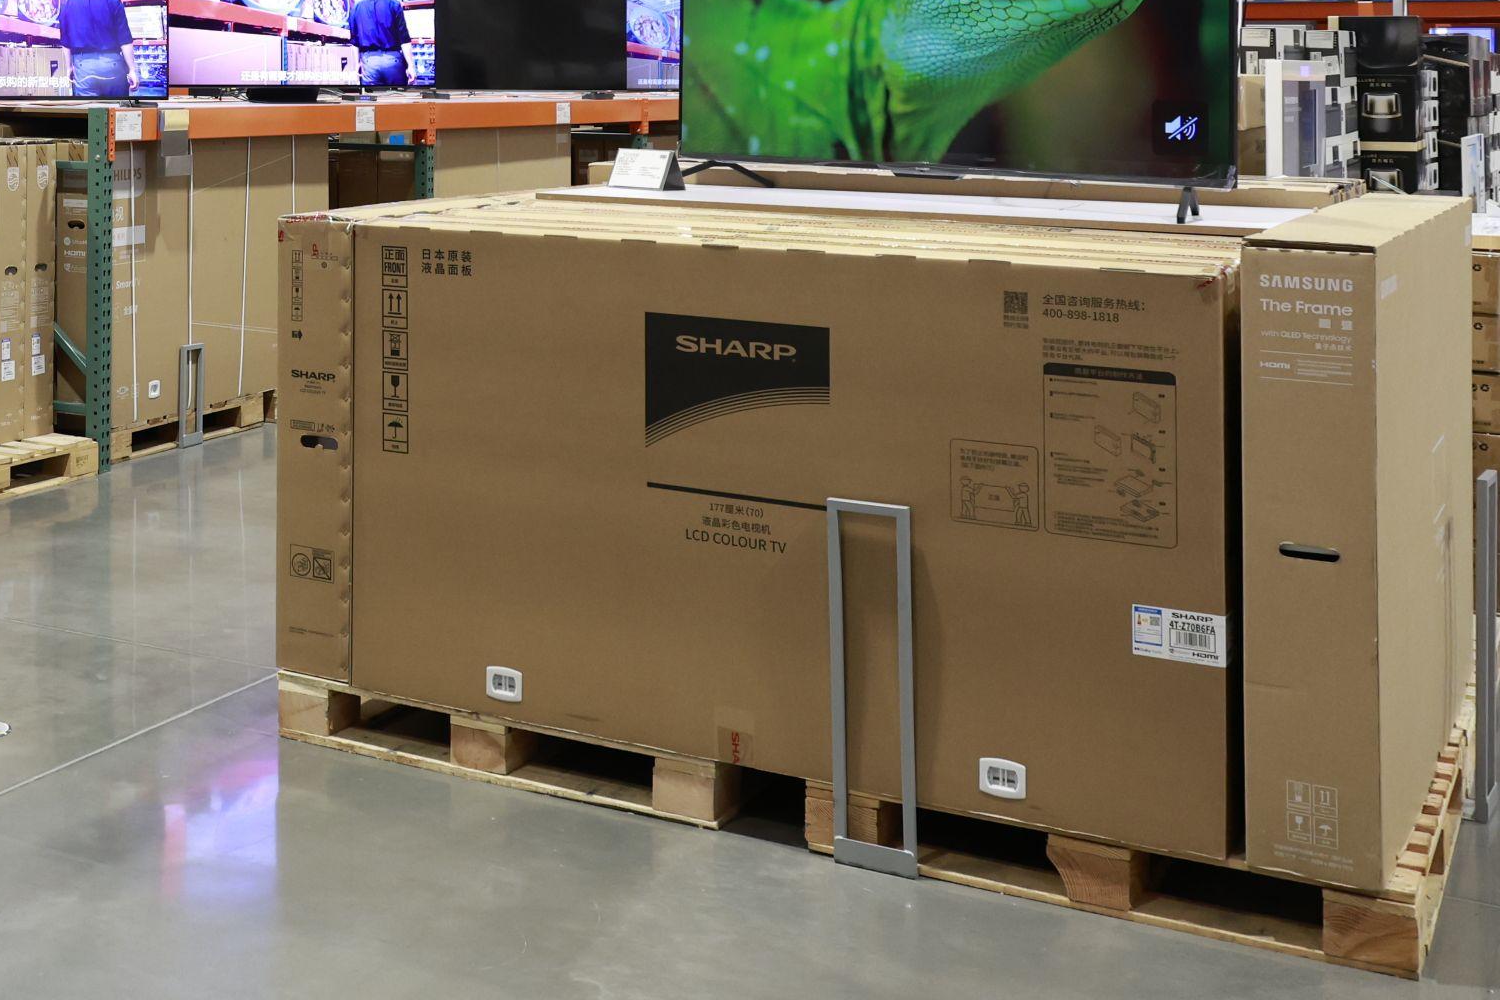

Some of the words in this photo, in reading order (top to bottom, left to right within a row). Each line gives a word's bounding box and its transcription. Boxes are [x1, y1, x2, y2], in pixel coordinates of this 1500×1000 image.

[113, 168, 142, 182] HILIS
[64, 249, 86, 257] HDMI
[384, 248, 405, 261] 正面
[421, 248, 473, 263] 日本原装
[384, 261, 405, 274] FRONT
[421, 262, 473, 277] 液晶面板
[116, 279, 134, 290] Smar
[1260, 274, 1354, 292] SAMSUNG
[1260, 298, 1292, 312] The
[1295, 300, 1354, 316] Frame
[1042, 309, 1120, 323] 400-898-1818
[1281, 331, 1301, 339] QLED
[675, 334, 797, 361] SHARP
[1260, 360, 1291, 370] HDMI
[291, 369, 336, 382] SHARP
[701, 516, 772, 536] 液晶彩色电视机
[685, 528, 710, 543] LCD
[712, 532, 767, 551] COLOUR
[769, 540, 788, 554] TV
[1171, 612, 1214, 623] SHARP
[1169, 620, 1216, 635] 4T-Z70B6FA
[1192, 651, 1219, 661] HDMI
